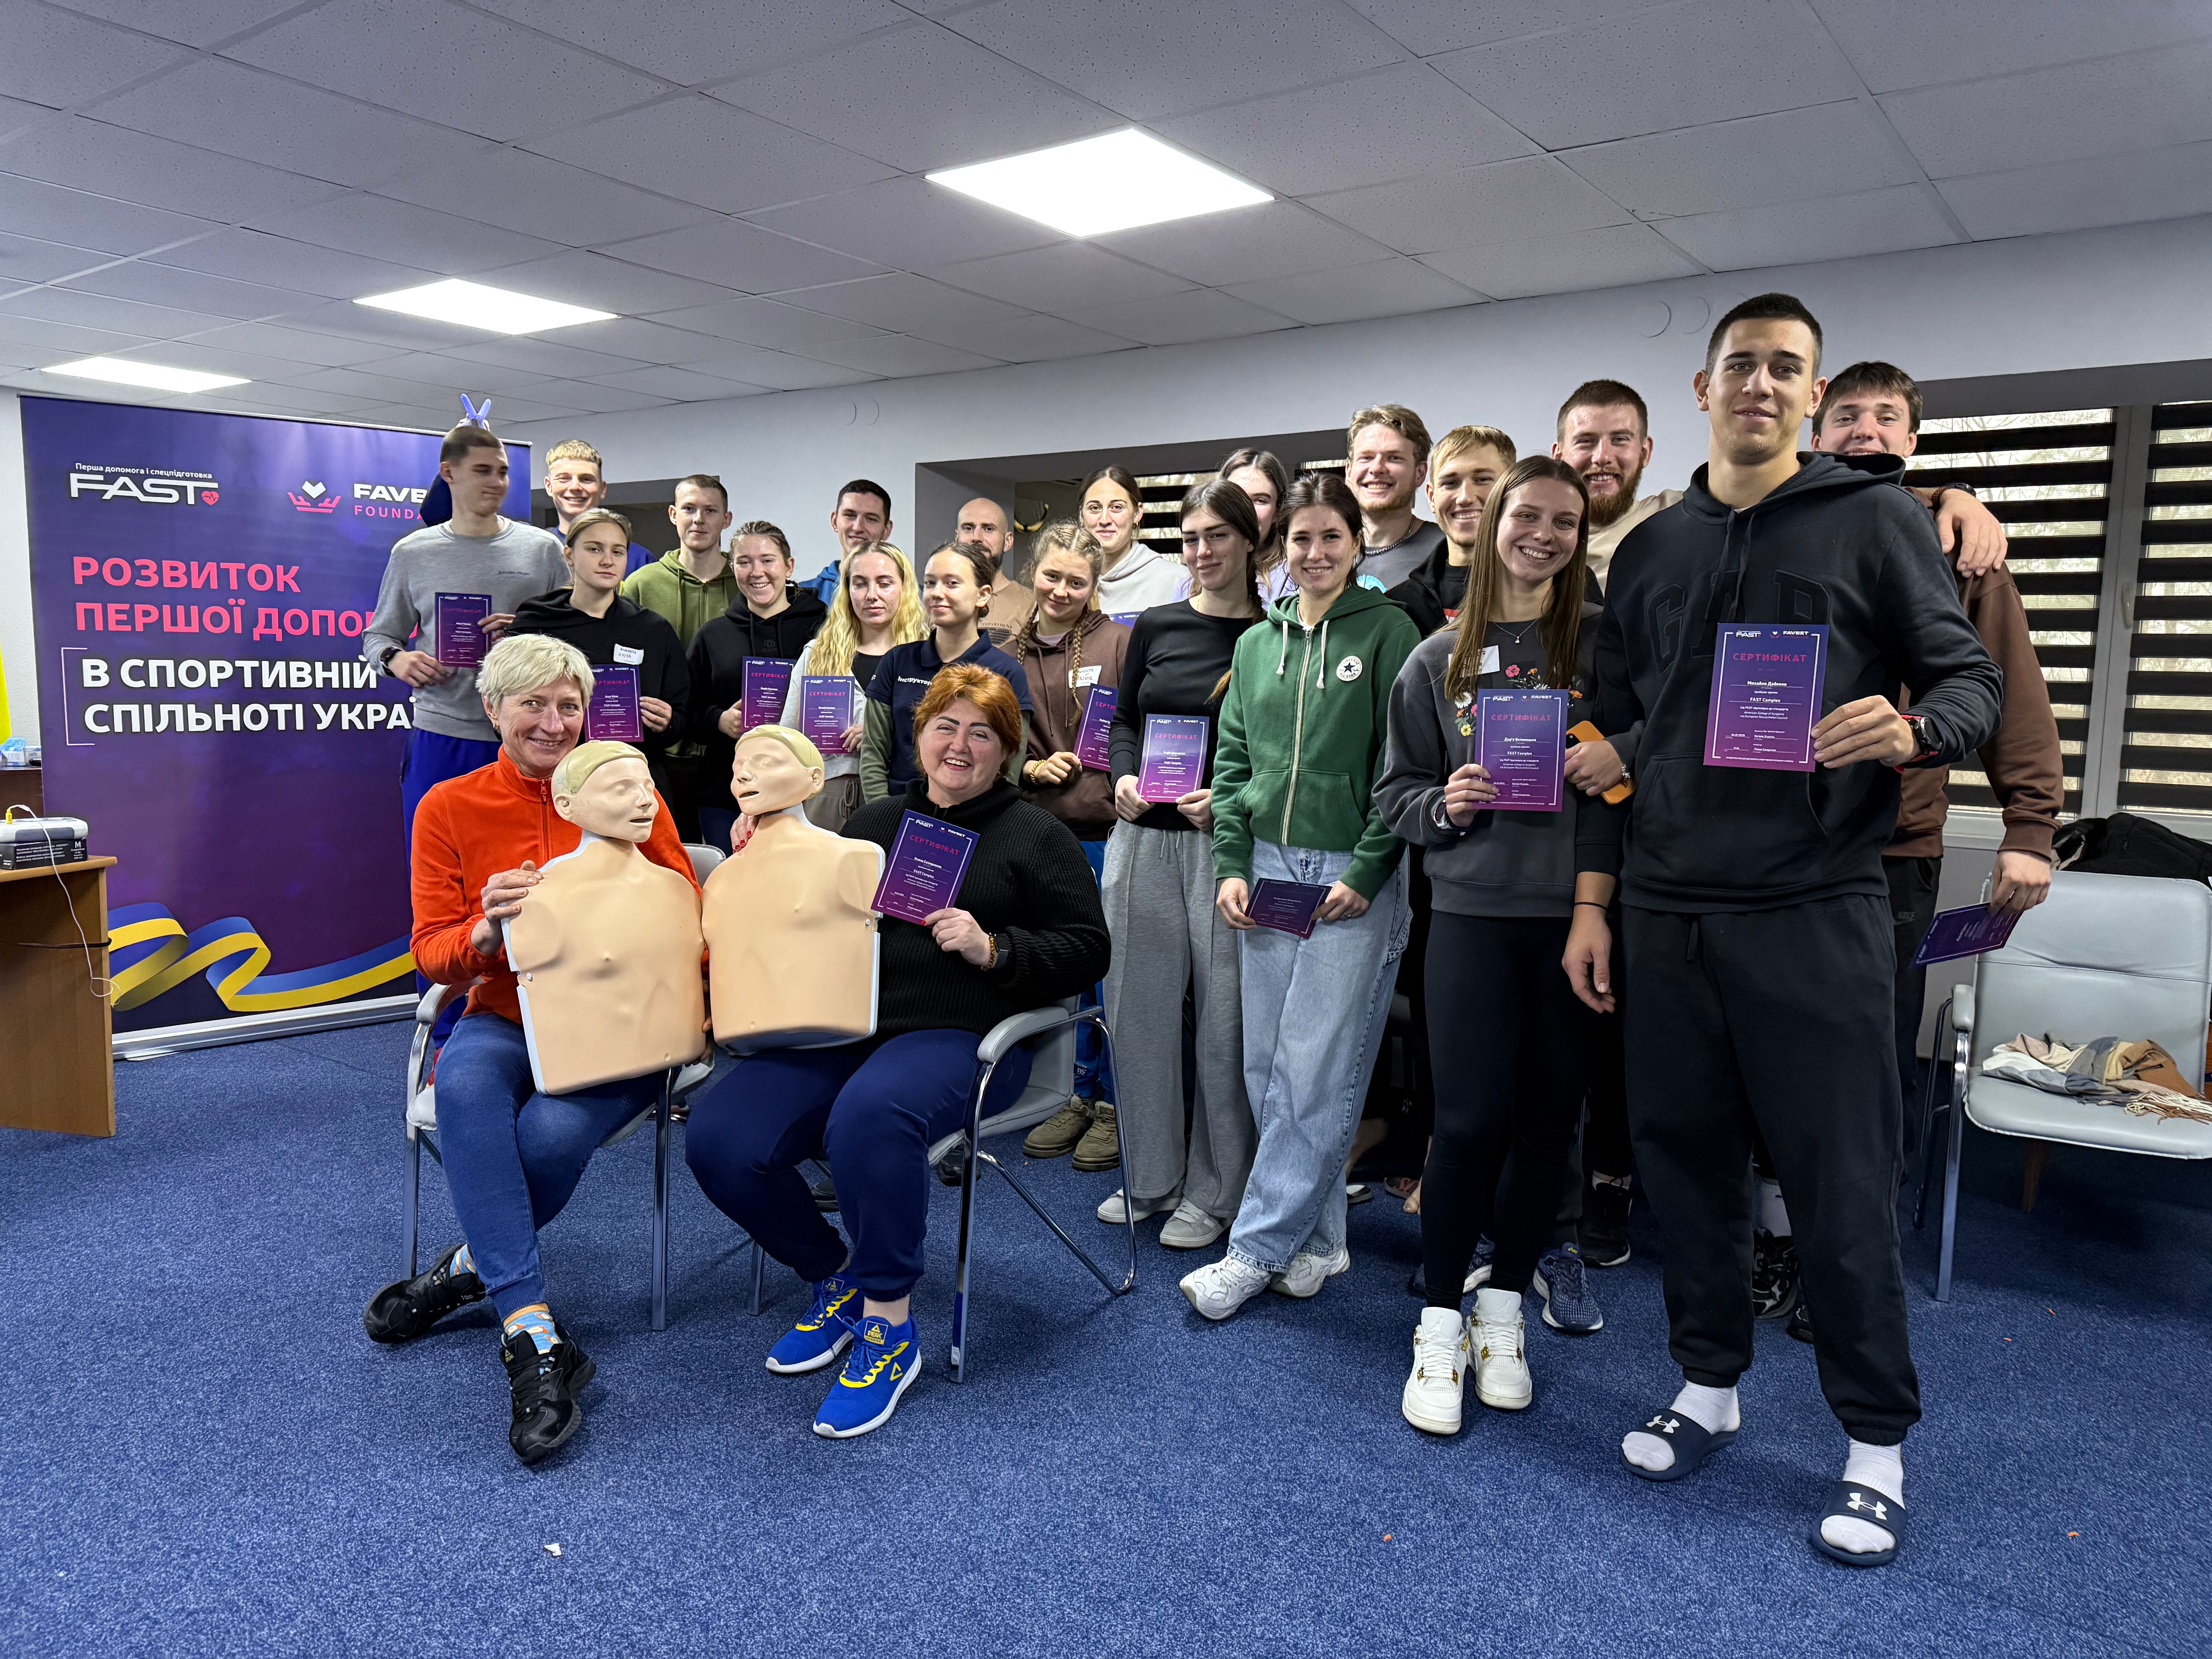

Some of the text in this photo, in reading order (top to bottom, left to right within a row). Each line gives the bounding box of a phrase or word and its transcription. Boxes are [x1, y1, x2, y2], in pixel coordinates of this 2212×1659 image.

[76, 463, 103, 472] Перша
[105, 465, 144, 474] допомога
[150, 469, 212, 479] спецпідготовка
[70, 473, 218, 505] FAST
[73, 556, 301, 593] РОЗВИТОК
[76, 598, 246, 634] ПЕРШОЇ
[82, 656, 377, 689] В СПОРТИВНІЙ
[1733, 653, 1807, 662] СЕРТИФІКАТ
[84, 696, 417, 733] СПІЛЬНОТІ УКРА
[910, 835, 960, 855] СЕРТИФІКАТ
